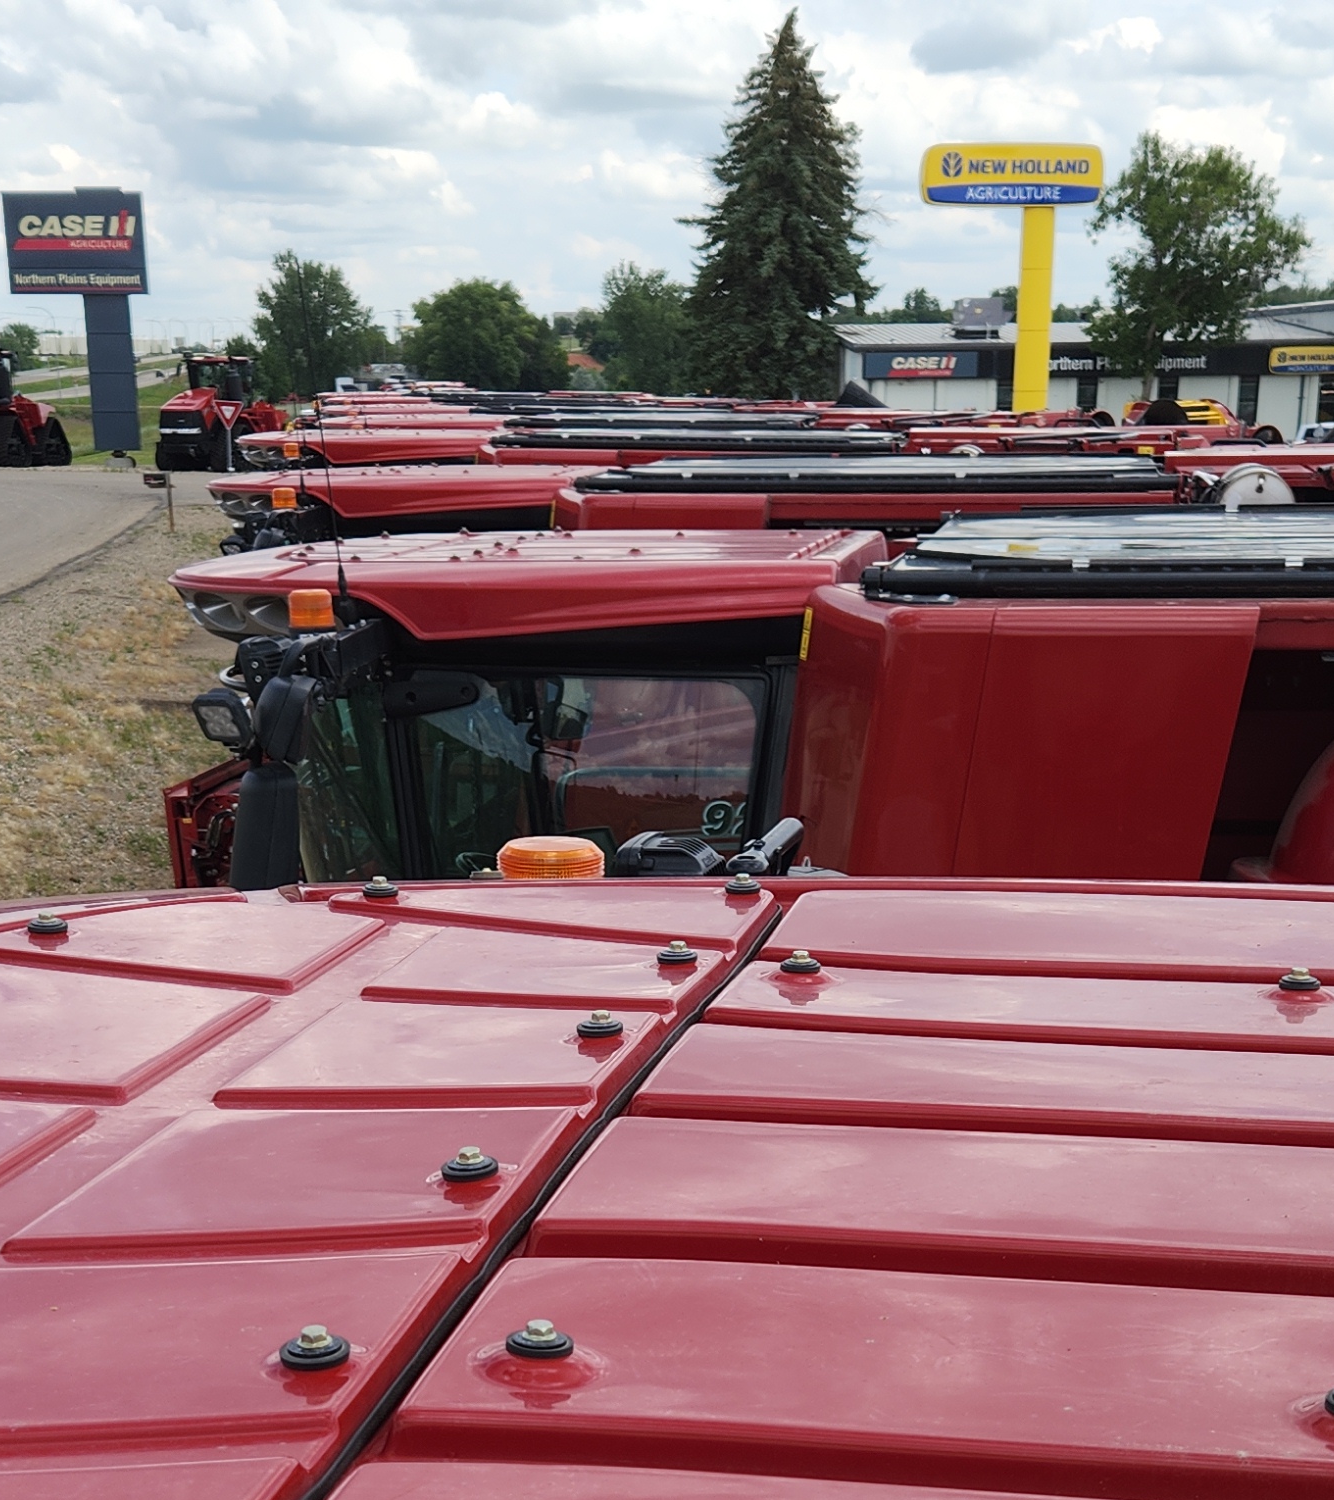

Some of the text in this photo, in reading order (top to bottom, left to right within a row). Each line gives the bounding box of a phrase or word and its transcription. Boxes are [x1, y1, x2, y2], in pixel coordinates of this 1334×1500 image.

[968, 159, 1089, 174] NEW HOLLAND
[965, 187, 1061, 200] AGRICULTURE
[18, 215, 105, 237] CASE
[69, 240, 129, 250] AGRICULTURE
[14, 273, 141, 287] Northern Plains Equipment
[891, 356, 940, 370] CASE
[1048, 356, 1094, 371] orthern
